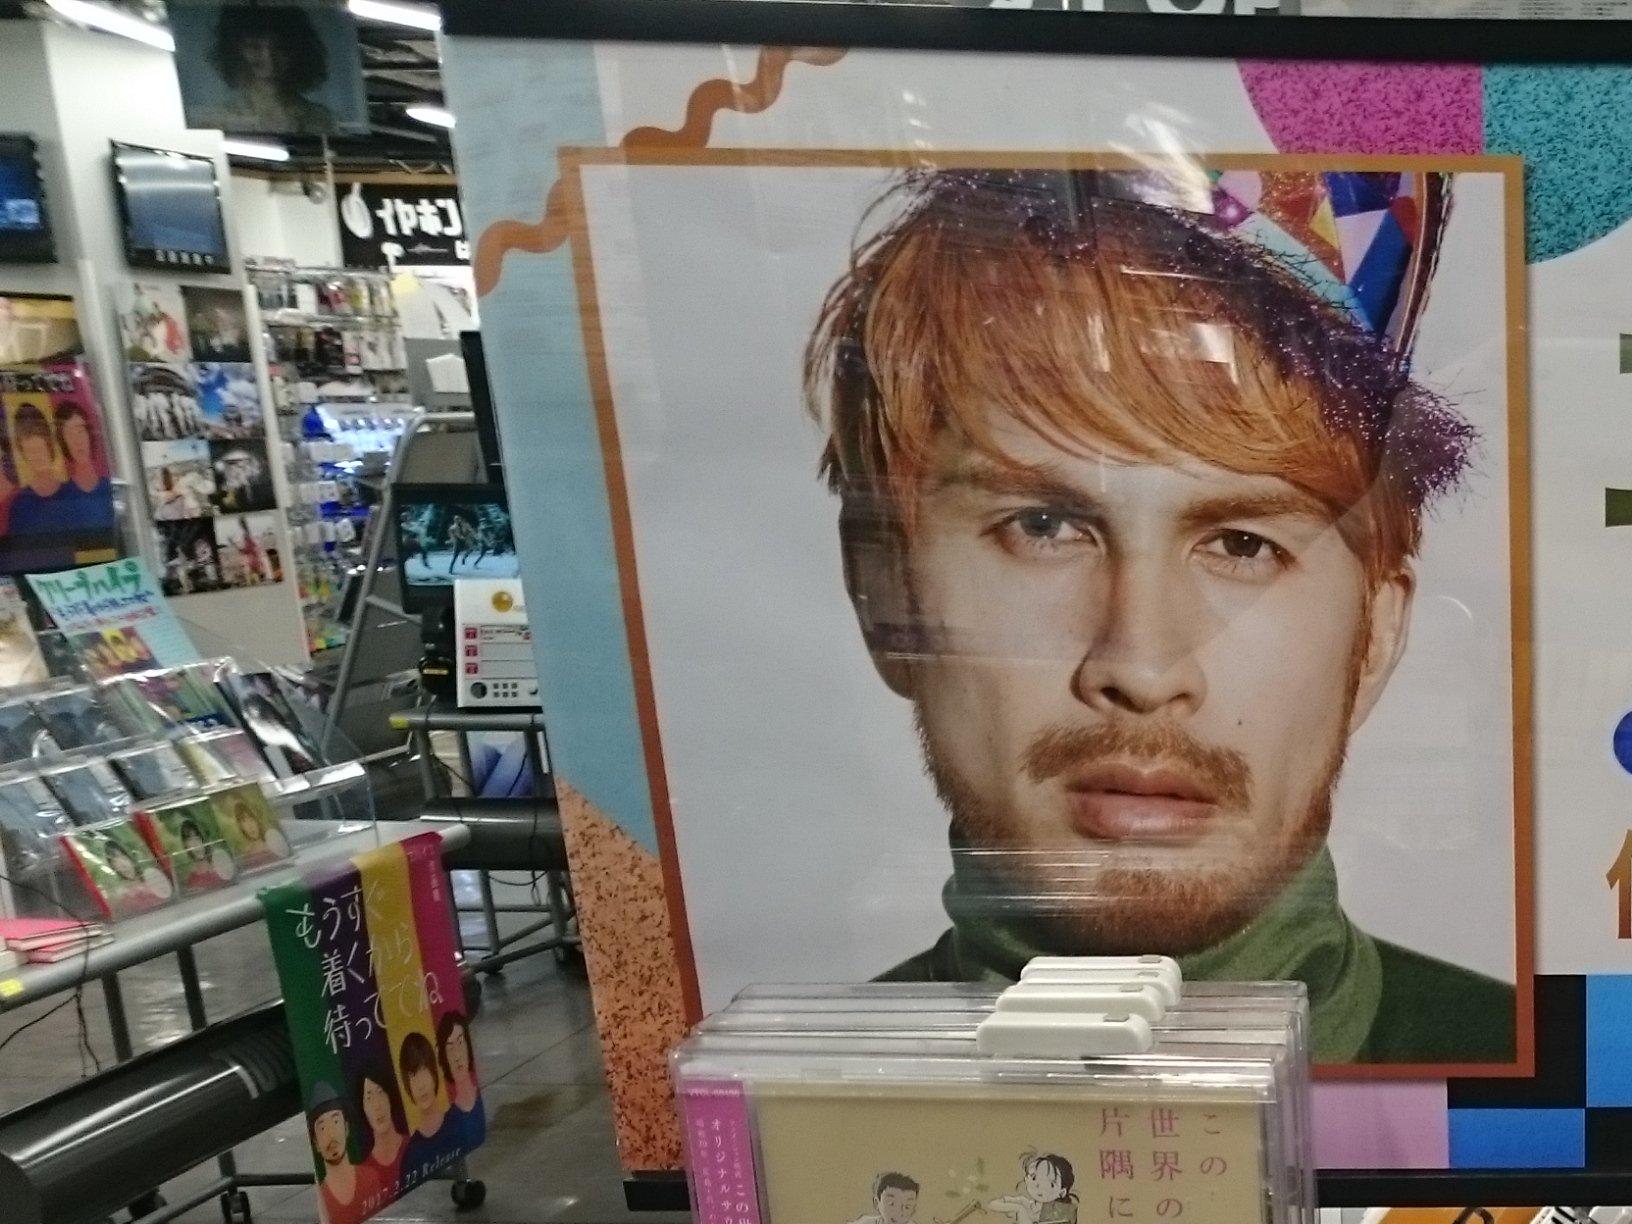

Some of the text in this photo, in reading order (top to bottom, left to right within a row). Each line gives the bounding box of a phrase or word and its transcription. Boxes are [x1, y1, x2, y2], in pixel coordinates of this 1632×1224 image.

[1100, 1107, 1134, 1219] 片隅に
[1148, 1107, 1183, 1218] 世界の
[1200, 1113, 1228, 1176] この
